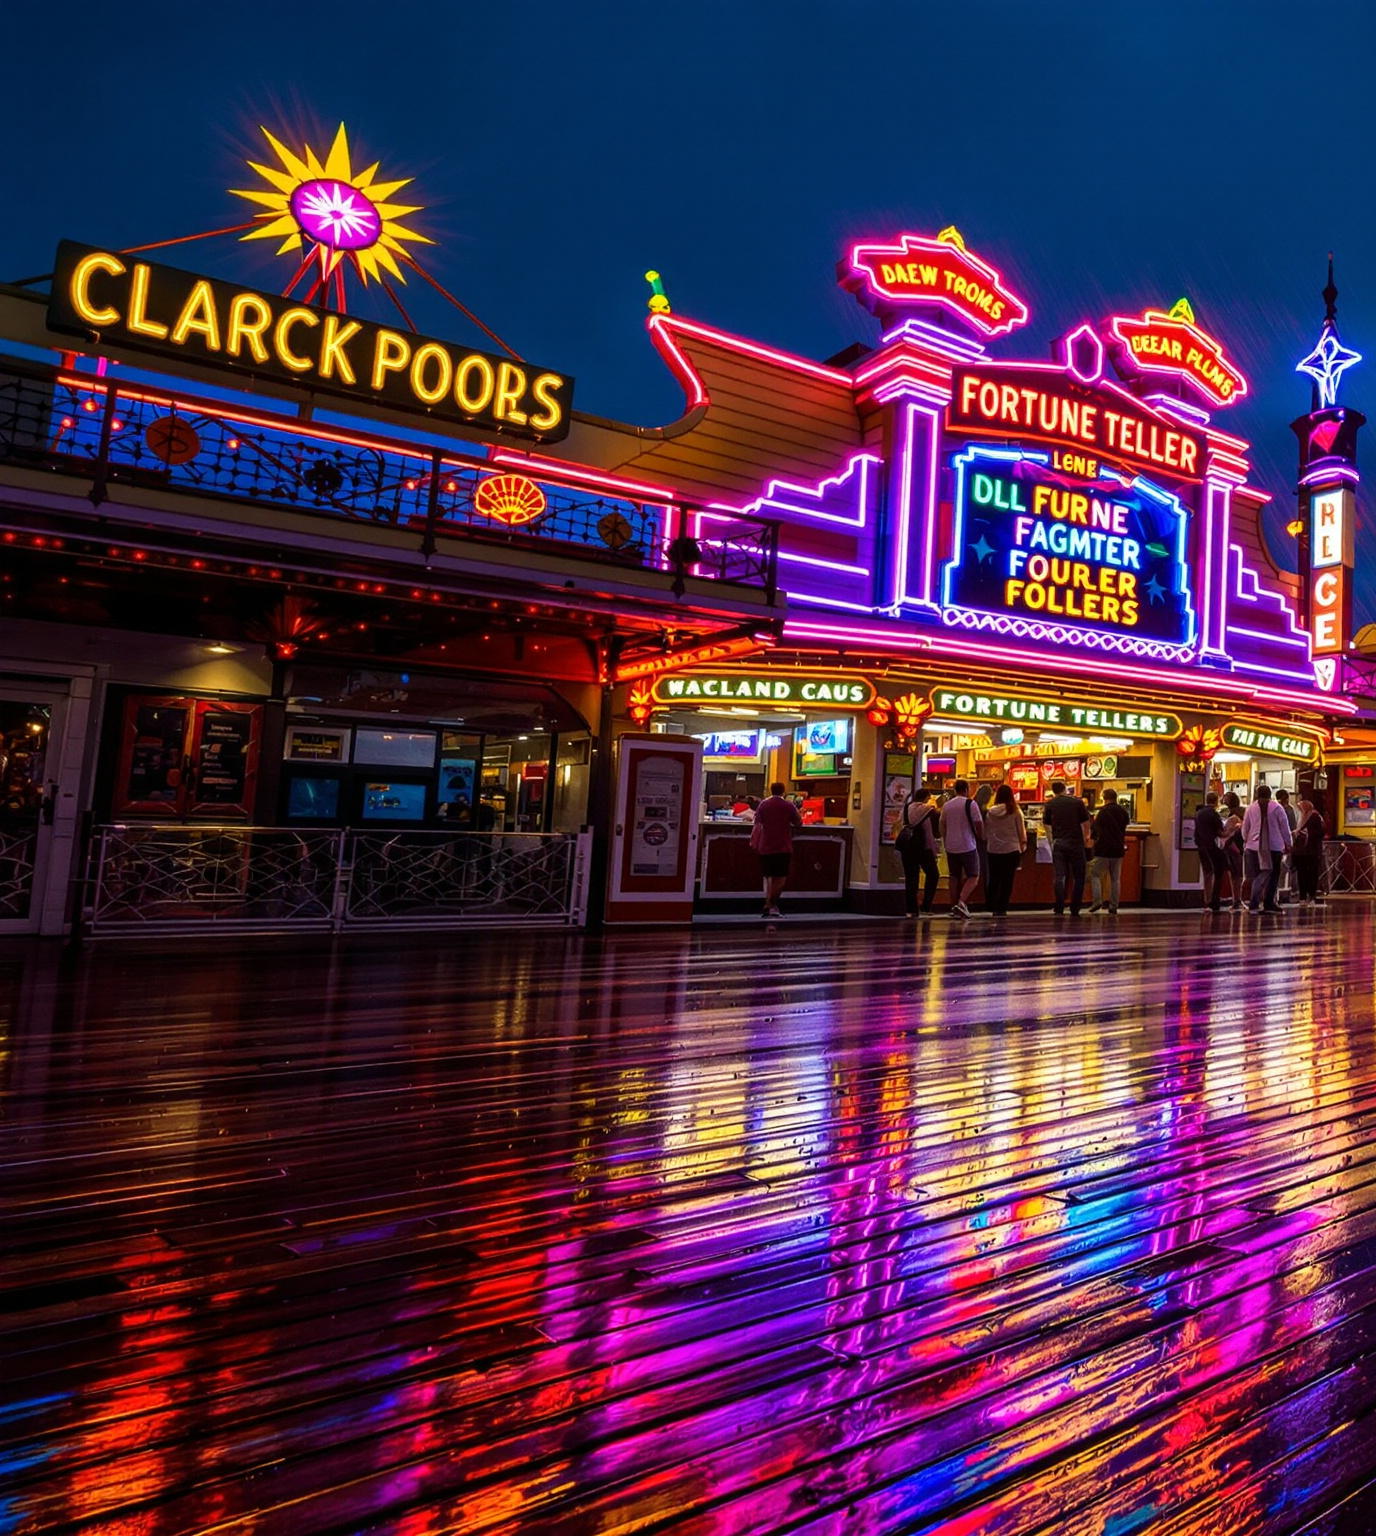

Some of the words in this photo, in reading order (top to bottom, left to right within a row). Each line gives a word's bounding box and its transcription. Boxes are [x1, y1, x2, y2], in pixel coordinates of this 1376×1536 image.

[70, 251, 364, 385] CLARCK
[370, 328, 565, 431] POORS
[962, 375, 1098, 441] FORTUNE
[1104, 411, 1198, 474] TELLER
[974, 473, 1026, 512] DLL
[1015, 516, 1141, 570] FAGMTER
[1006, 579, 1139, 625] FOLLERS
[667, 680, 791, 699] WACLAND
[801, 682, 864, 701] CAUS
[940, 692, 1060, 723] FORTUNE
[1071, 708, 1169, 734] TELLERS
